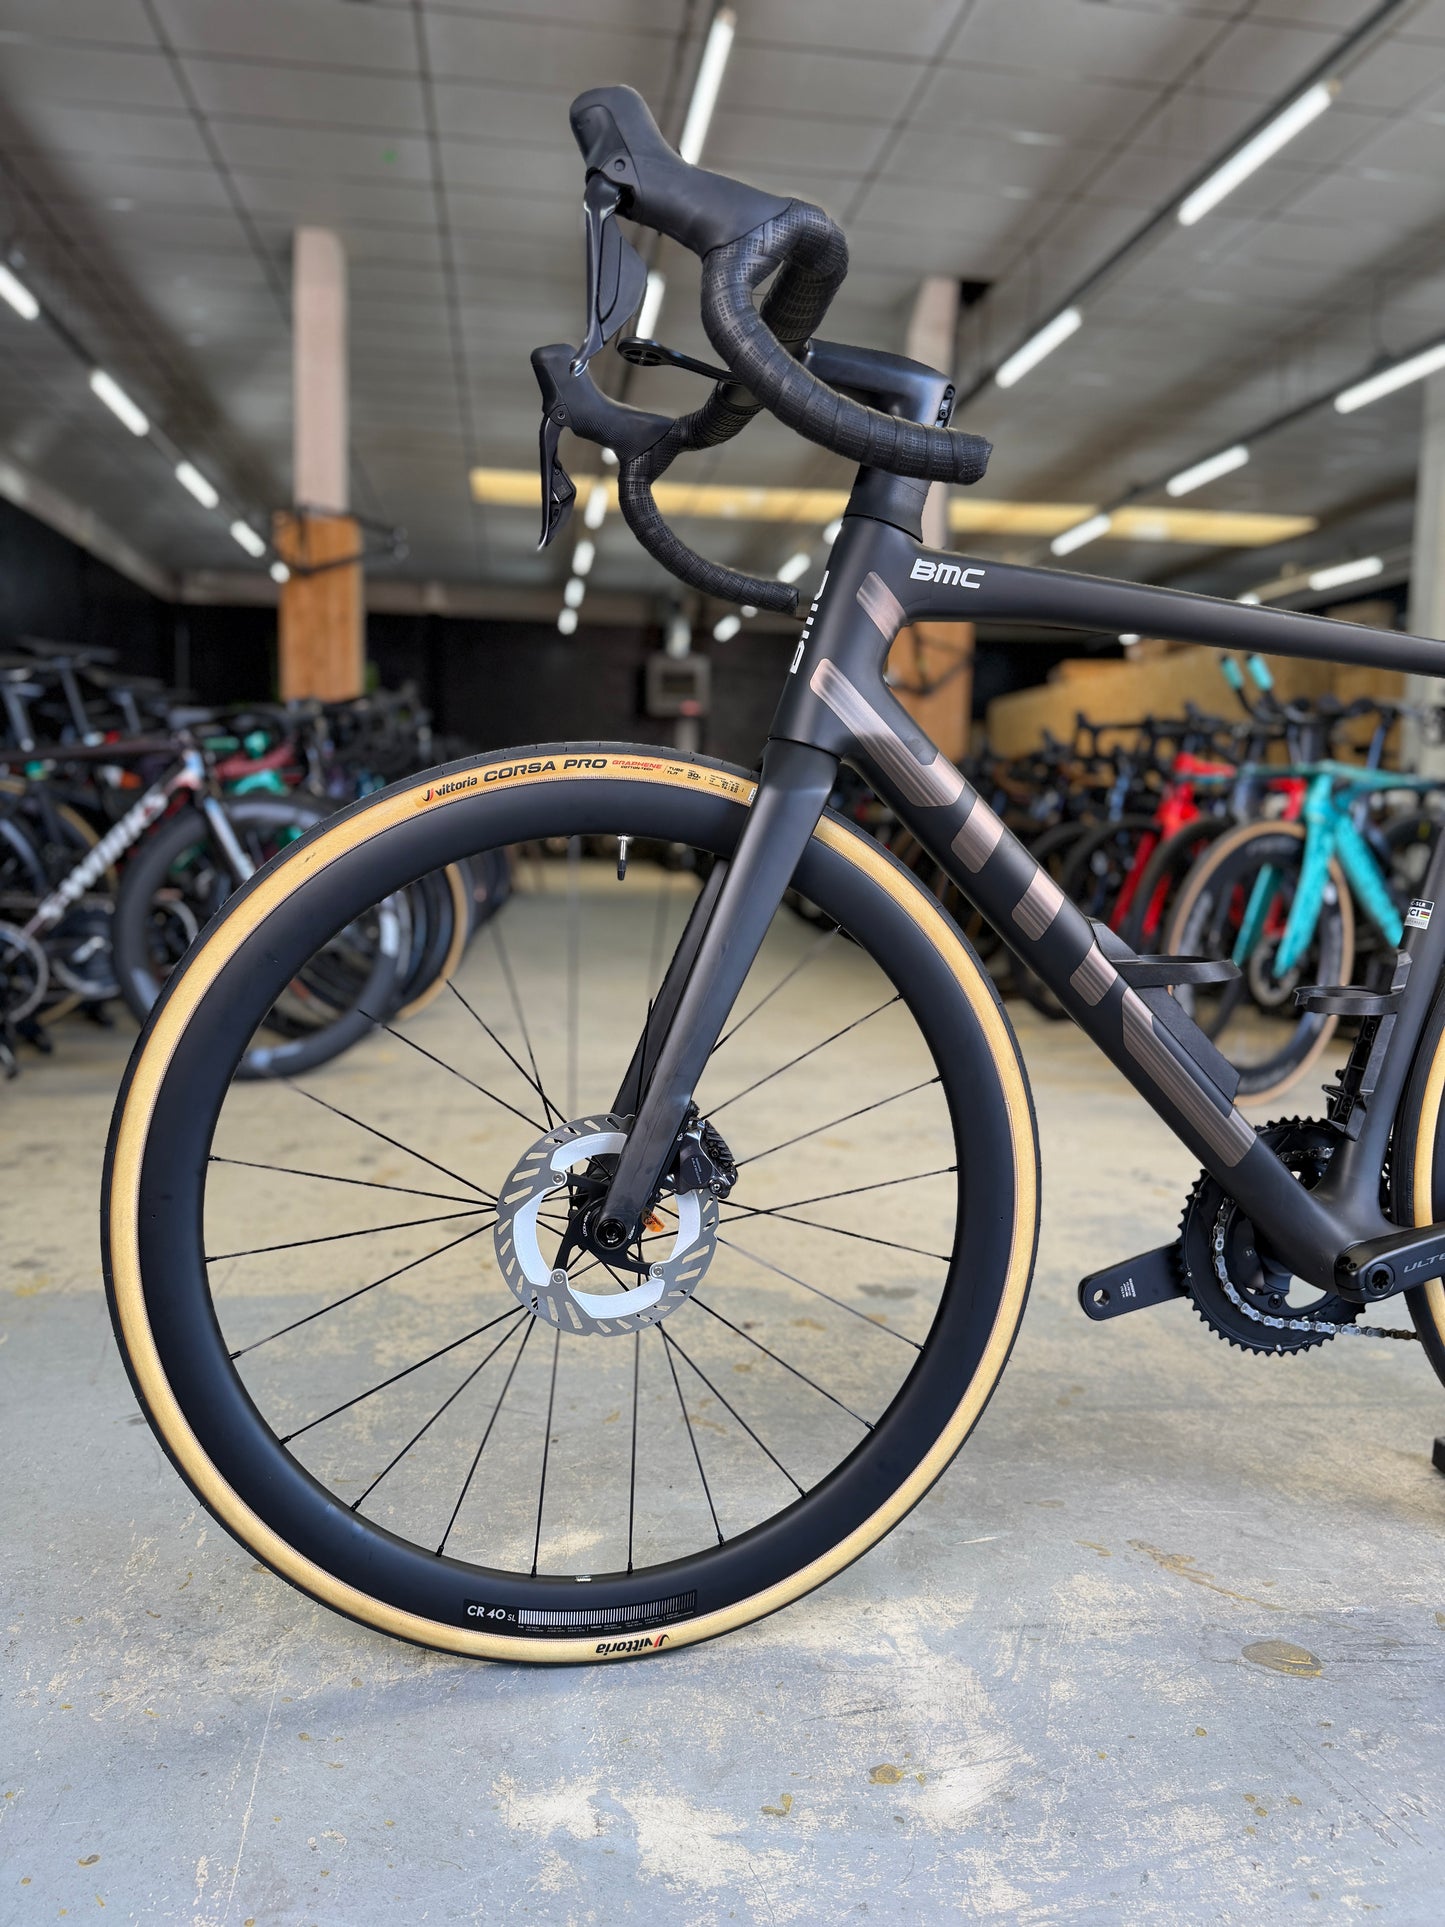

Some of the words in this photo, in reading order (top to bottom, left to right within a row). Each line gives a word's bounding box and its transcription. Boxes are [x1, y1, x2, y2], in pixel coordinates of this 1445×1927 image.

[909, 557, 986, 590] BMC
[612, 759, 663, 770] GRAPHENE
[435, 776, 478, 797] vittoria
[483, 760, 557, 783] CORSA
[563, 759, 608, 770] PRO
[467, 1604, 485, 1618] CR
[486, 1608, 506, 1620] 40
[507, 1613, 516, 1622] SL
[595, 1637, 654, 1656] vittoria
